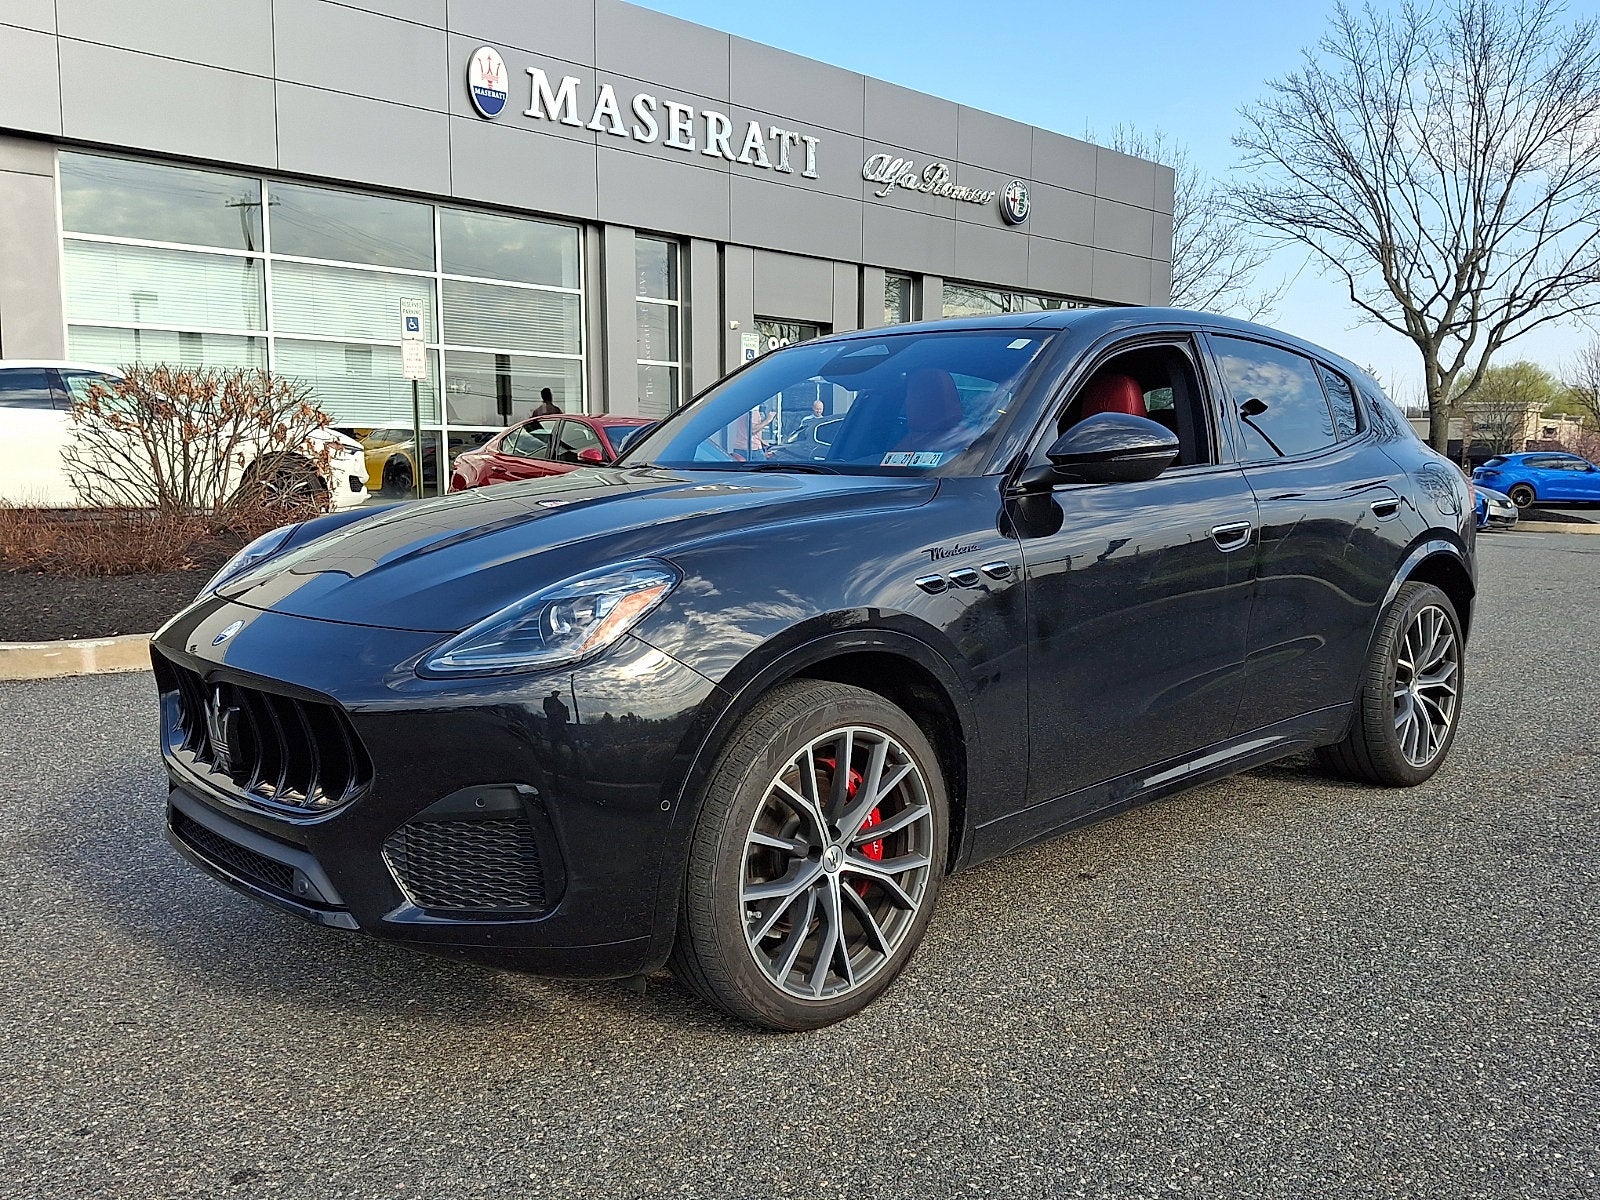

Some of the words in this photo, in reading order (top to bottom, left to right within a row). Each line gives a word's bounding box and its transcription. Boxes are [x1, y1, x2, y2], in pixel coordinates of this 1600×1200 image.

[474, 87, 506, 101] MASERATI
[523, 66, 821, 179] MASERATI
[862, 153, 919, 198] Alfa
[919, 162, 996, 205] Romeo
